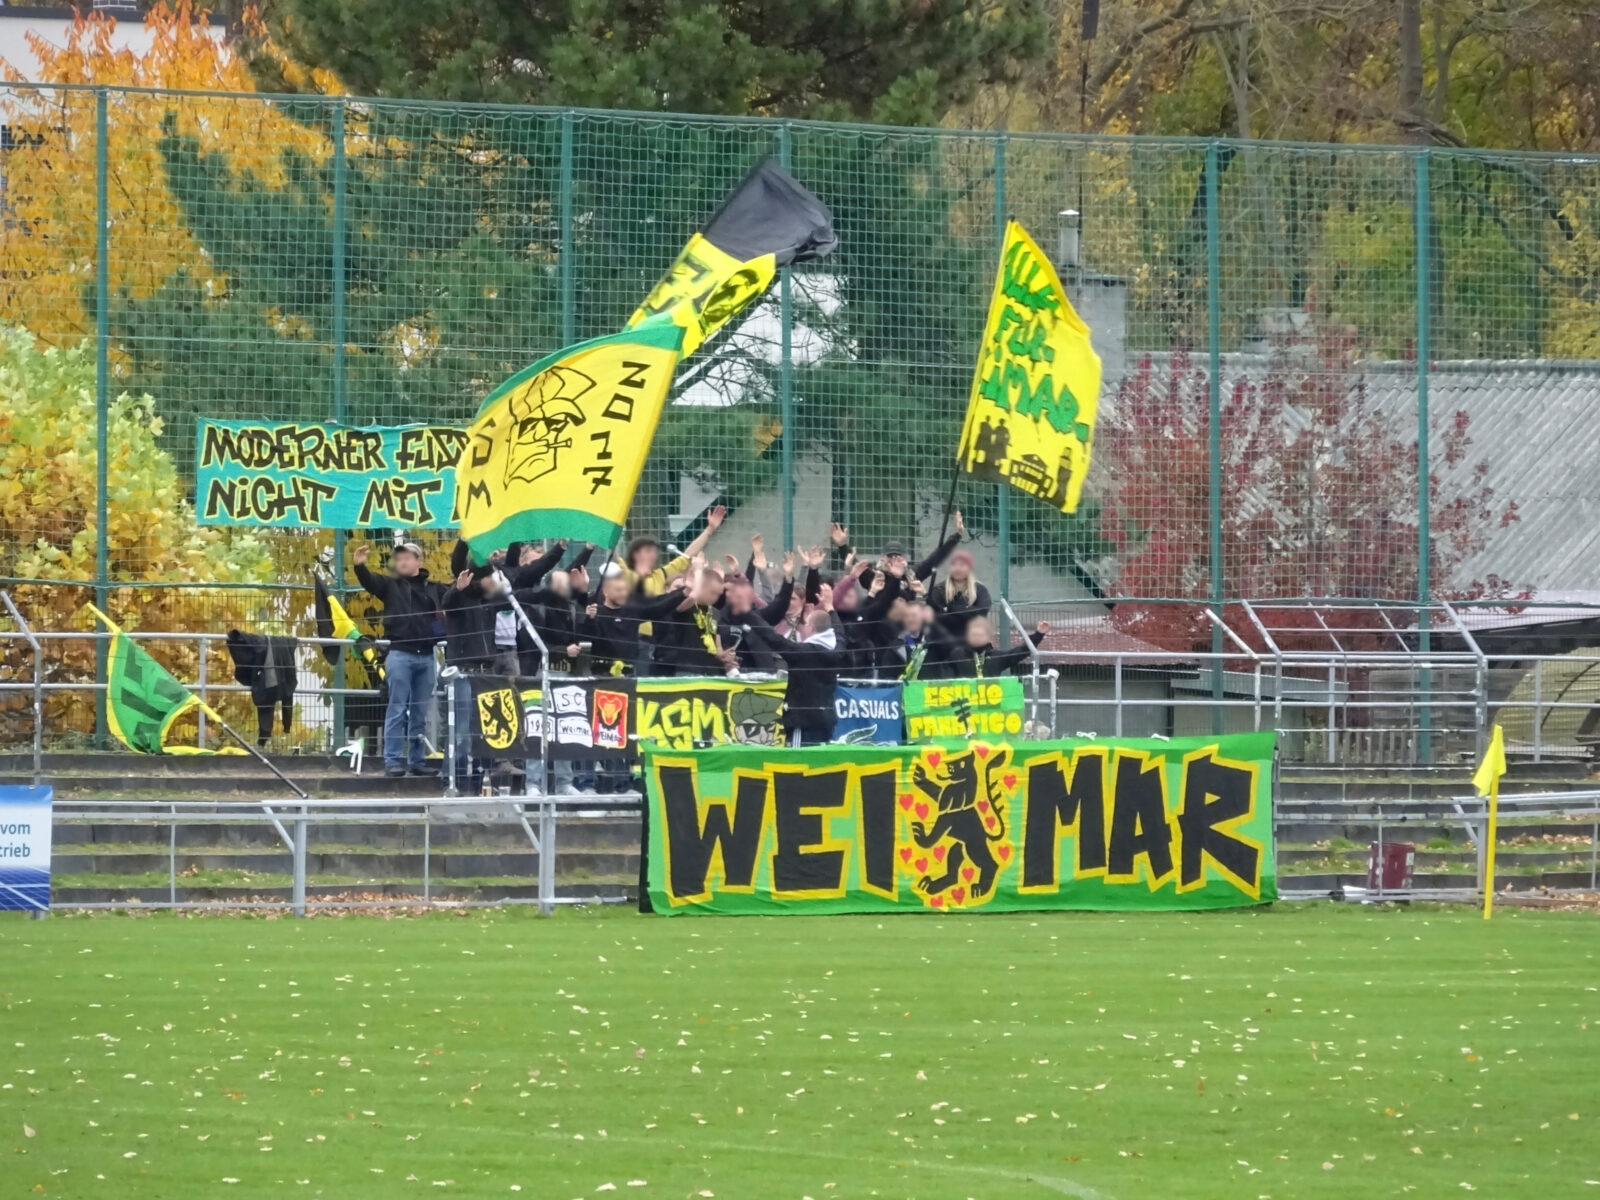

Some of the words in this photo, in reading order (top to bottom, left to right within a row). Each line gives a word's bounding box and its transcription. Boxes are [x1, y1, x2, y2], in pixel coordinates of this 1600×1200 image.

[202, 424, 388, 473] MODERNER
[561, 692, 583, 707] SC
[922, 683, 1004, 707] ESILIO
[834, 698, 900, 721] CASUALS
[530, 719, 551, 735] 193
[908, 711, 1023, 740] FANATICO
[0, 823, 31, 835] vom
